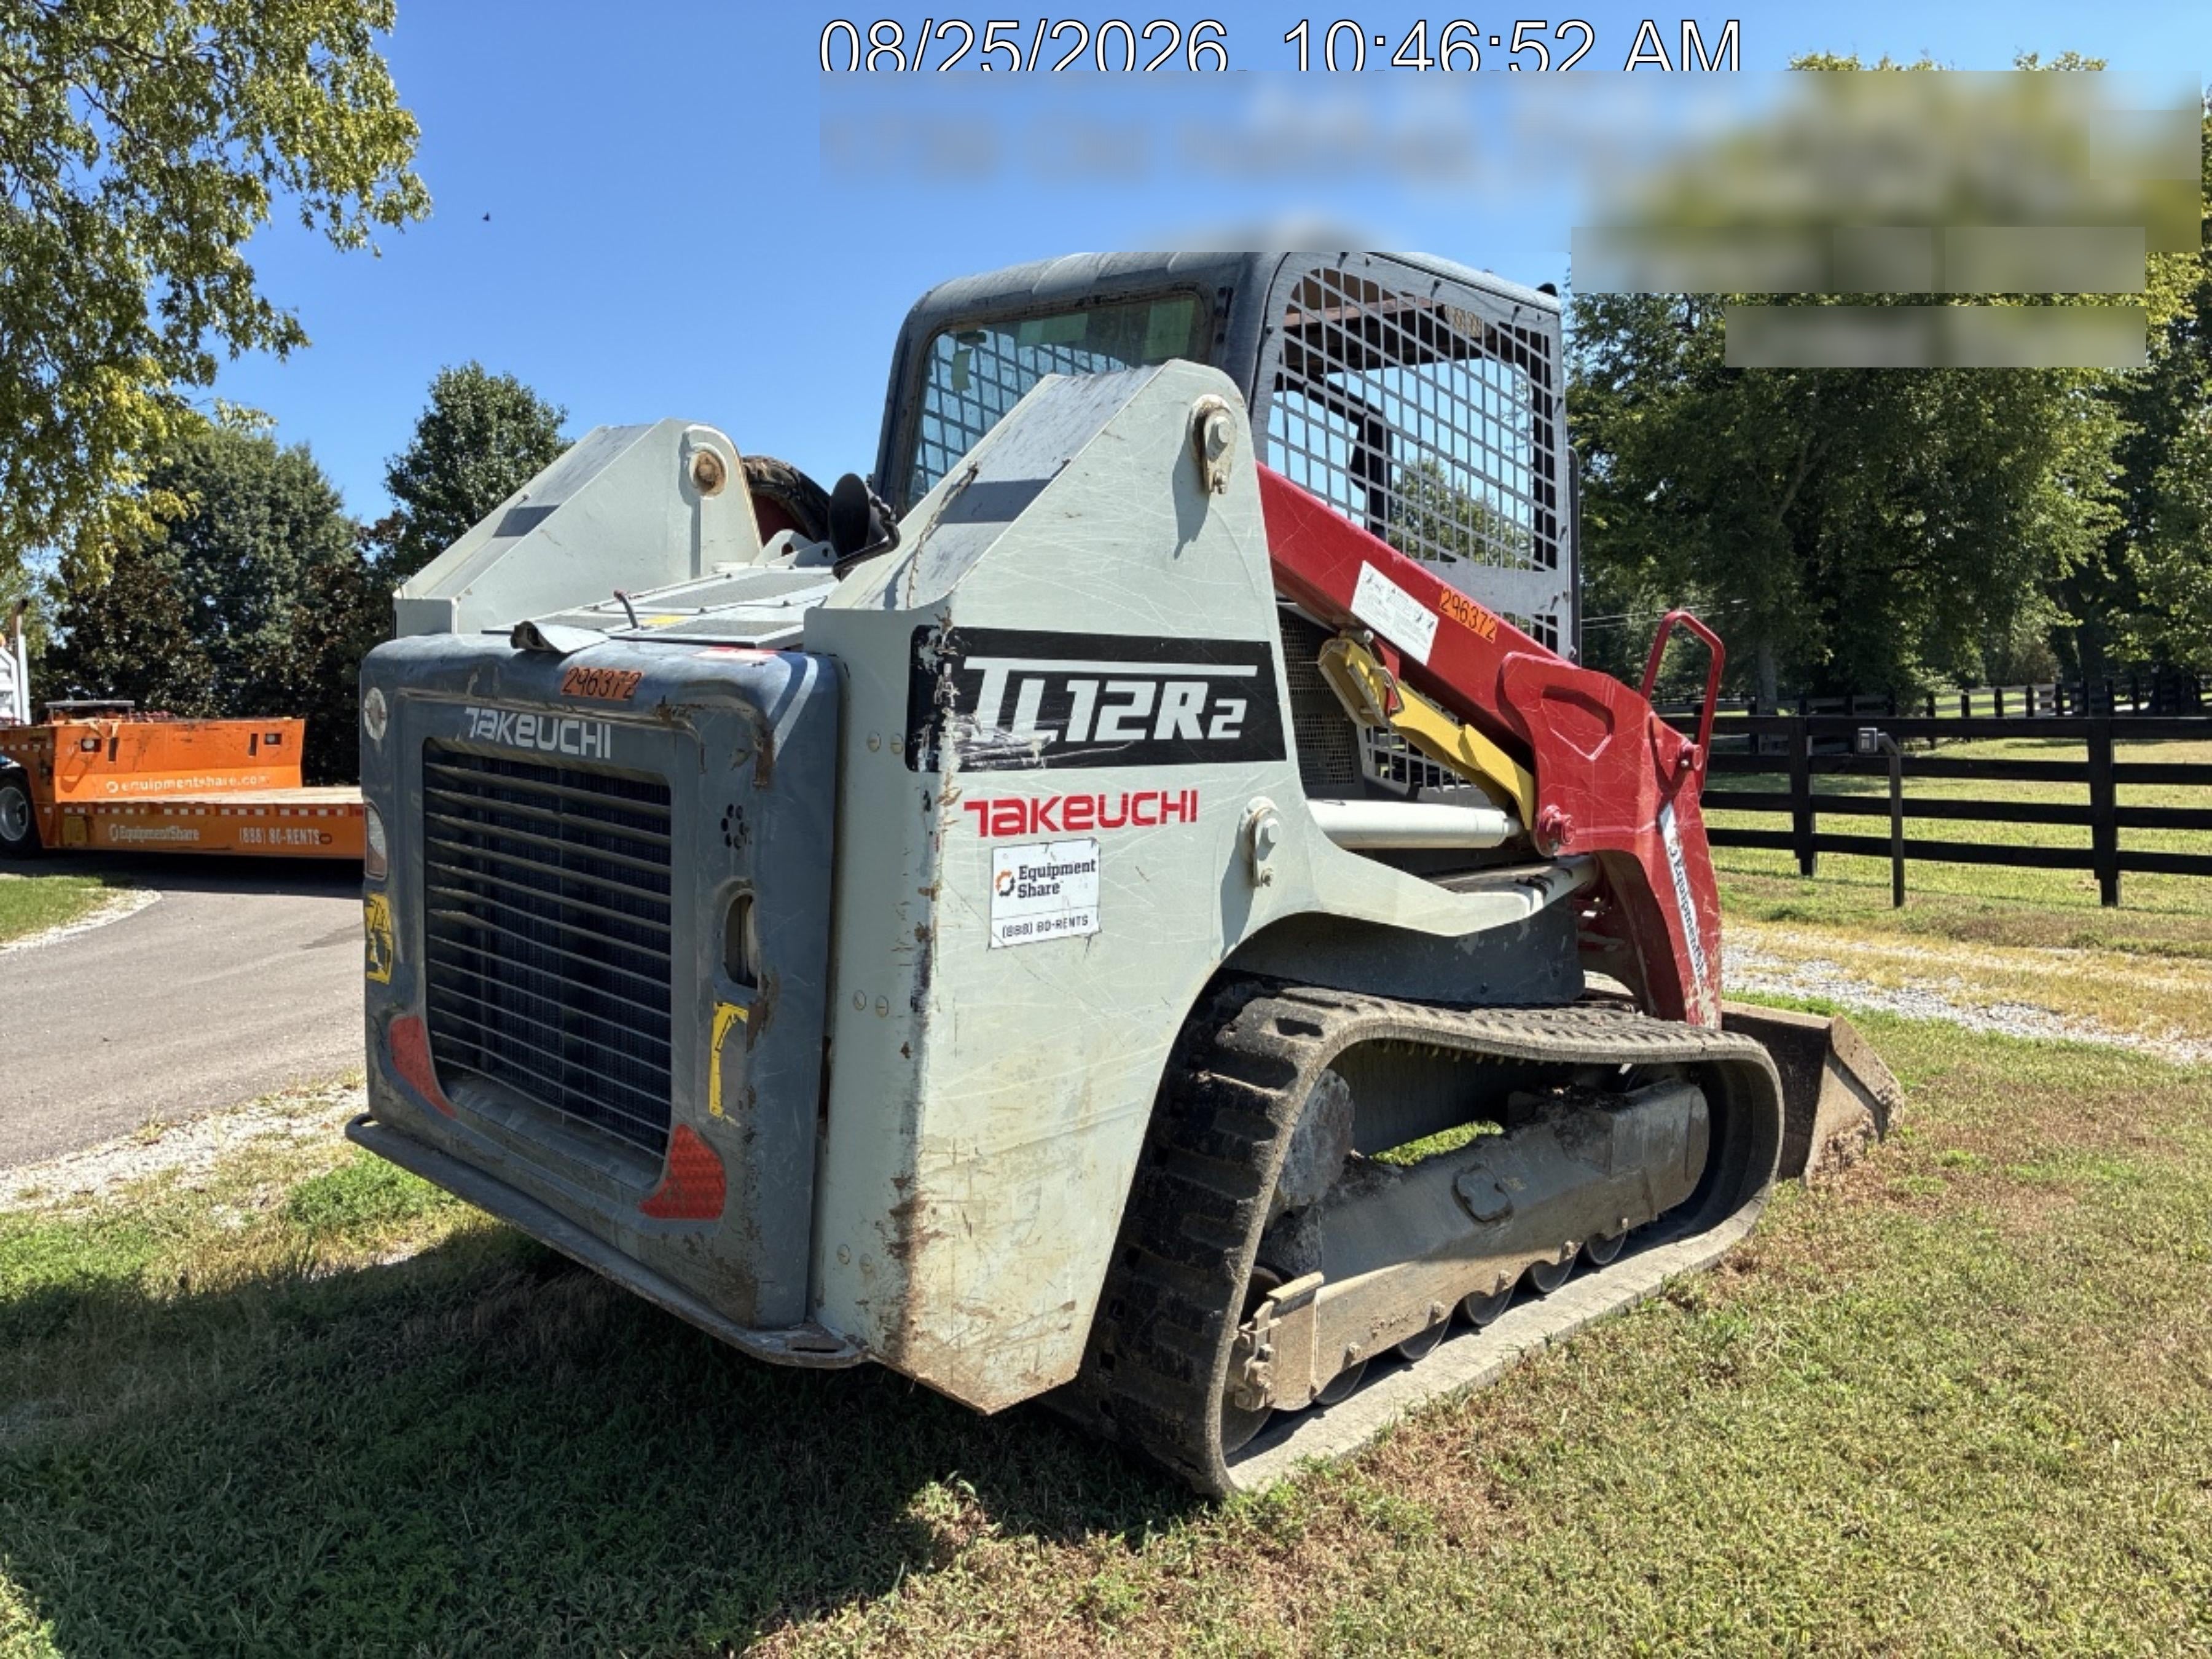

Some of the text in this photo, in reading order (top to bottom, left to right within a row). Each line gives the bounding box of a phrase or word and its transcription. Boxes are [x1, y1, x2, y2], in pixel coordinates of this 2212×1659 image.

[1440, 588, 1497, 642] 296372
[562, 667, 642, 699] 296372
[1018, 858, 1096, 882] Equipment
[1018, 882, 1061, 898] Share
[1002, 914, 1089, 938] (888) 80-RENTS
